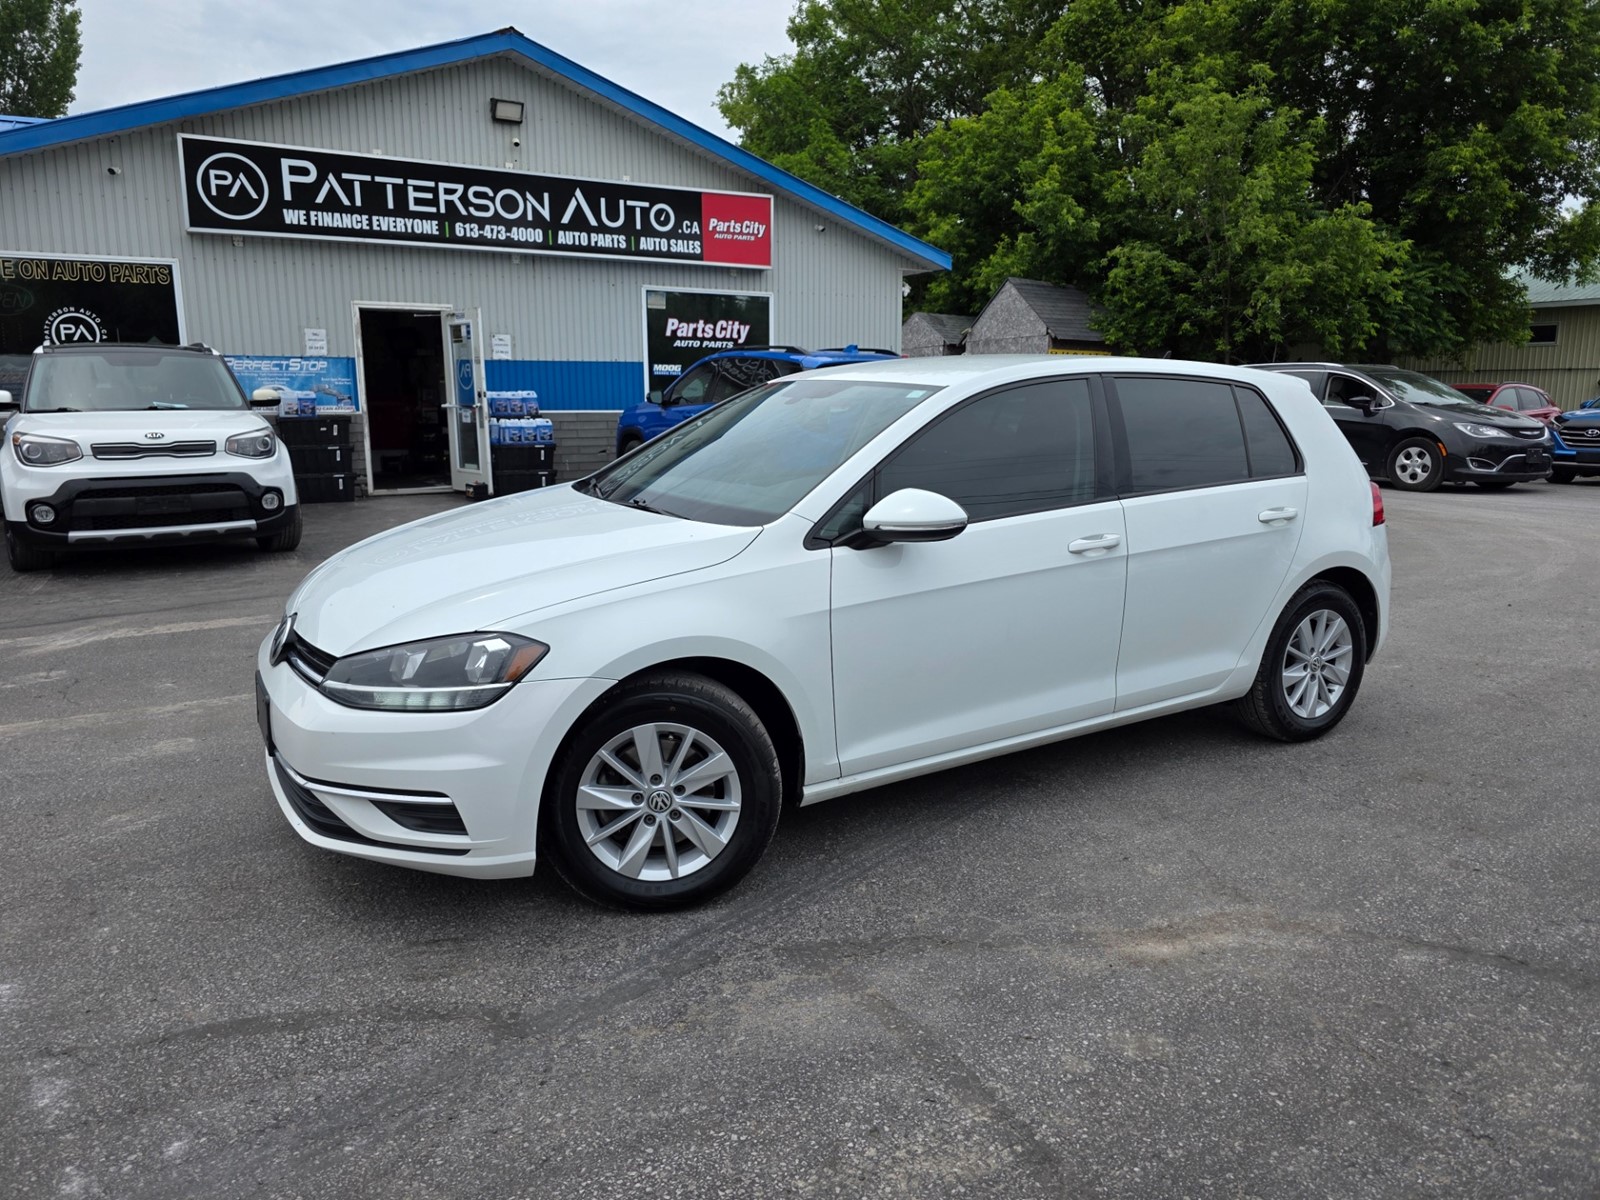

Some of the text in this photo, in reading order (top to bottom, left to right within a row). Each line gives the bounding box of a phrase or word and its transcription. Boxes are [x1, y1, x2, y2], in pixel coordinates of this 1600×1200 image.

[208, 168, 259, 200] PA
[280, 157, 550, 222] PATTERSON
[283, 208, 439, 235] WE FINANCE EVERYONE
[455, 222, 543, 243] 613-473-4000
[557, 230, 626, 249] AUTO PARTS
[639, 236, 702, 254] AUTO SALES
[19, 260, 49, 280] ON
[53, 261, 106, 282] AUTO
[109, 264, 171, 284] PARTS
[44, 306, 75, 339] PATTERSON
[79, 308, 101, 323] AUTO
[60, 324, 93, 341] PA
[673, 340, 734, 349] AUTO PARTS
[653, 364, 682, 372] MOOG
